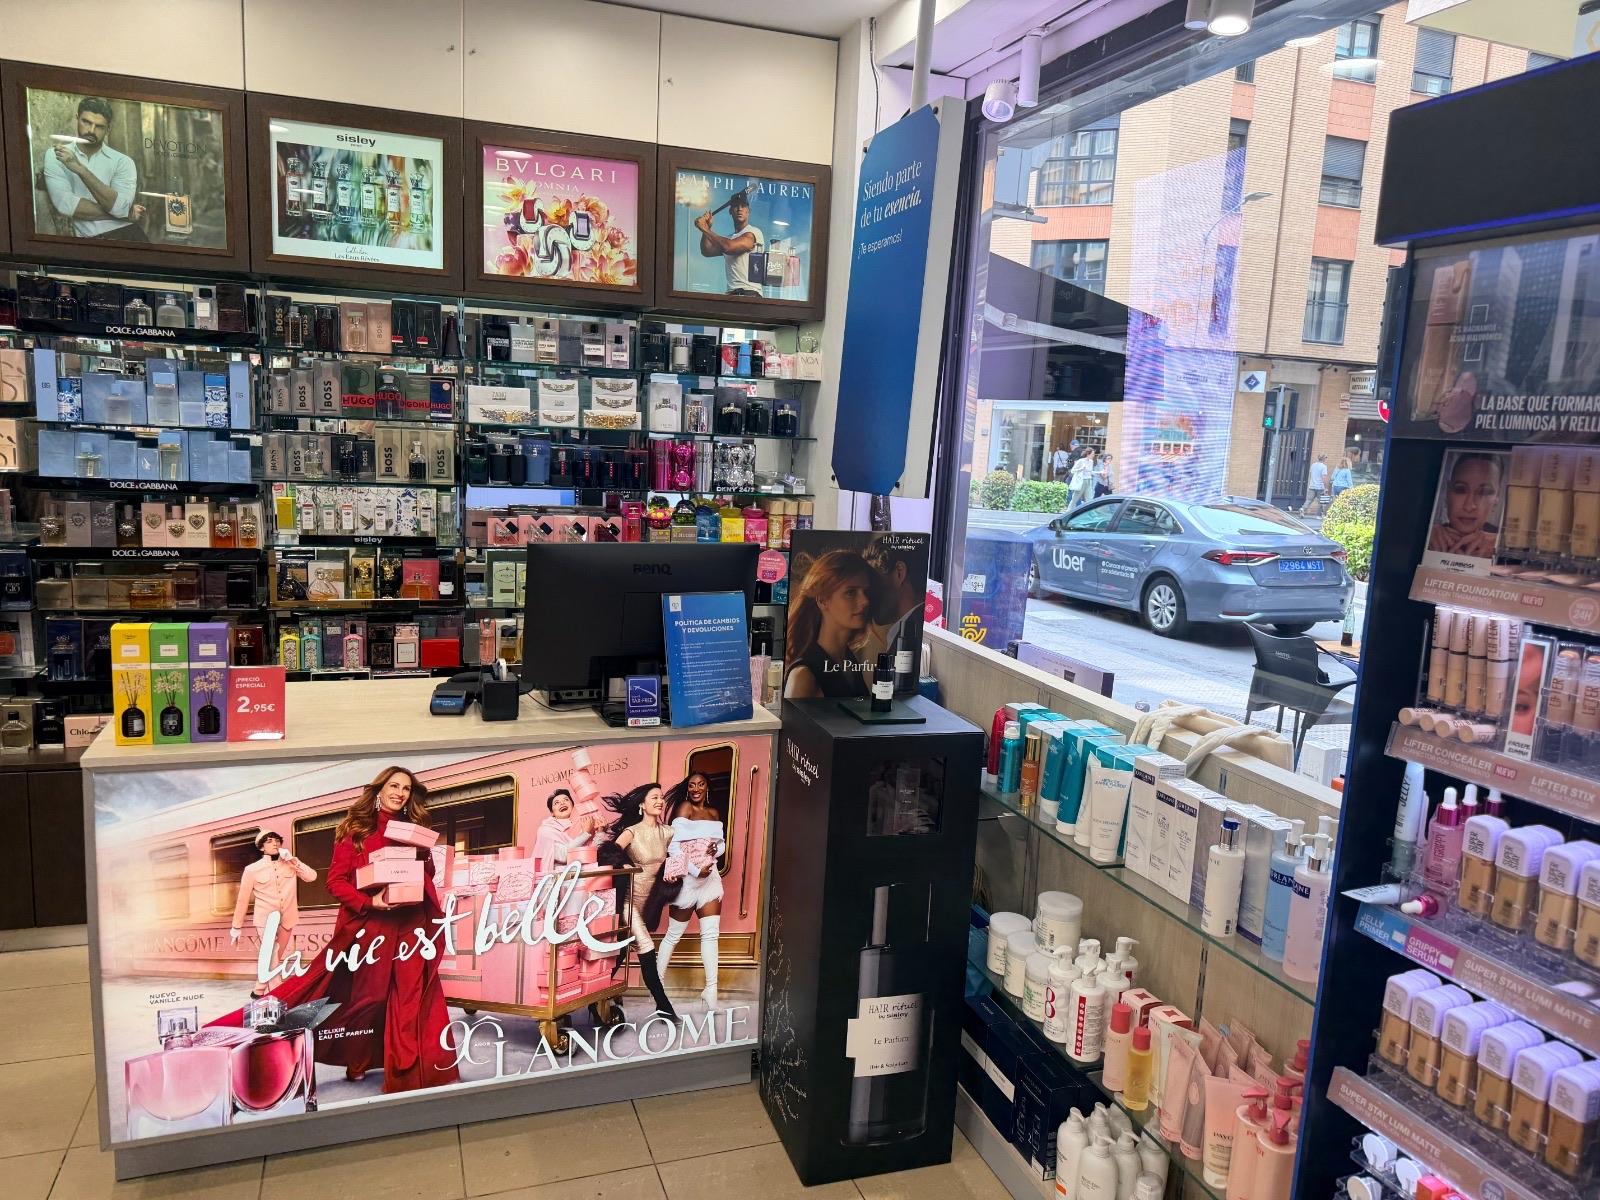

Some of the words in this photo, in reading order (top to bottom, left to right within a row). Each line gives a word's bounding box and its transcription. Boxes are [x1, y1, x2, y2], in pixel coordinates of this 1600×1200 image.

[336, 134, 376, 147] sisley
[495, 158, 617, 184] BVLGARI
[677, 172, 734, 190] RALPH
[862, 170, 893, 201] Siendo
[895, 160, 921, 191] parte
[860, 207, 872, 228] de
[873, 204, 883, 222] tu
[884, 186, 921, 218] esencia.
[868, 228, 903, 253] esperamos!
[323, 380, 331, 408] BOSS
[342, 395, 374, 406] HUGO
[1481, 396, 1495, 411] LA
[1496, 396, 1526, 411] BASE
[1527, 396, 1550, 412] QUE
[1475, 414, 1497, 429] PIEL
[1499, 415, 1556, 431] LUMINOSA
[1559, 416, 1568, 429] Y
[1569, 416, 1600, 432] RELL
[882, 536, 899, 545] HAIR
[901, 536, 924, 544] rituel
[1052, 548, 1085, 572] Uber
[1425, 578, 1454, 591] LIFTER
[1456, 583, 1519, 601] FOUNDATION
[688, 625, 734, 633] DEVOLUCIONES
[824, 660, 839, 672] Le
[843, 659, 876, 672] Parfu
[236, 695, 275, 714] 2,95€
[69, 728, 90, 736] Chlo
[1404, 737, 1434, 753] LIFTER
[1435, 746, 1493, 771] CONCEALER
[1399, 779, 1411, 807] JELLY
[1531, 775, 1568, 795] LIFTER
[1570, 788, 1597, 804] STIX
[1270, 869, 1294, 886] ORLAN
[475, 860, 635, 956] belle
[393, 893, 472, 962] est
[1360, 921, 1390, 941] PRIMER
[1361, 913, 1385, 930] JELLY
[325, 926, 387, 972] vie
[1406, 945, 1438, 967] SERUM
[1409, 936, 1441, 957] GRIPPY
[150, 997, 181, 1005] VANILLE
[1464, 959, 1498, 983] SUPER
[1498, 972, 1525, 993] STAY
[1525, 985, 1552, 1009] LUMI
[1553, 1000, 1592, 1029] MATTE
[868, 1004, 889, 1014] HAIR
[892, 1001, 918, 1011] rituel
[346, 1029, 374, 1037] PARFUM
[494, 1006, 750, 1079] LANCÔME
[1340, 1083, 1367, 1107] SUPER
[1367, 1097, 1390, 1119] STAY
[1388, 1110, 1411, 1137] LUMI
[1409, 1133, 1442, 1160] MATTE
[1213, 1132, 1234, 1140] PAYO
